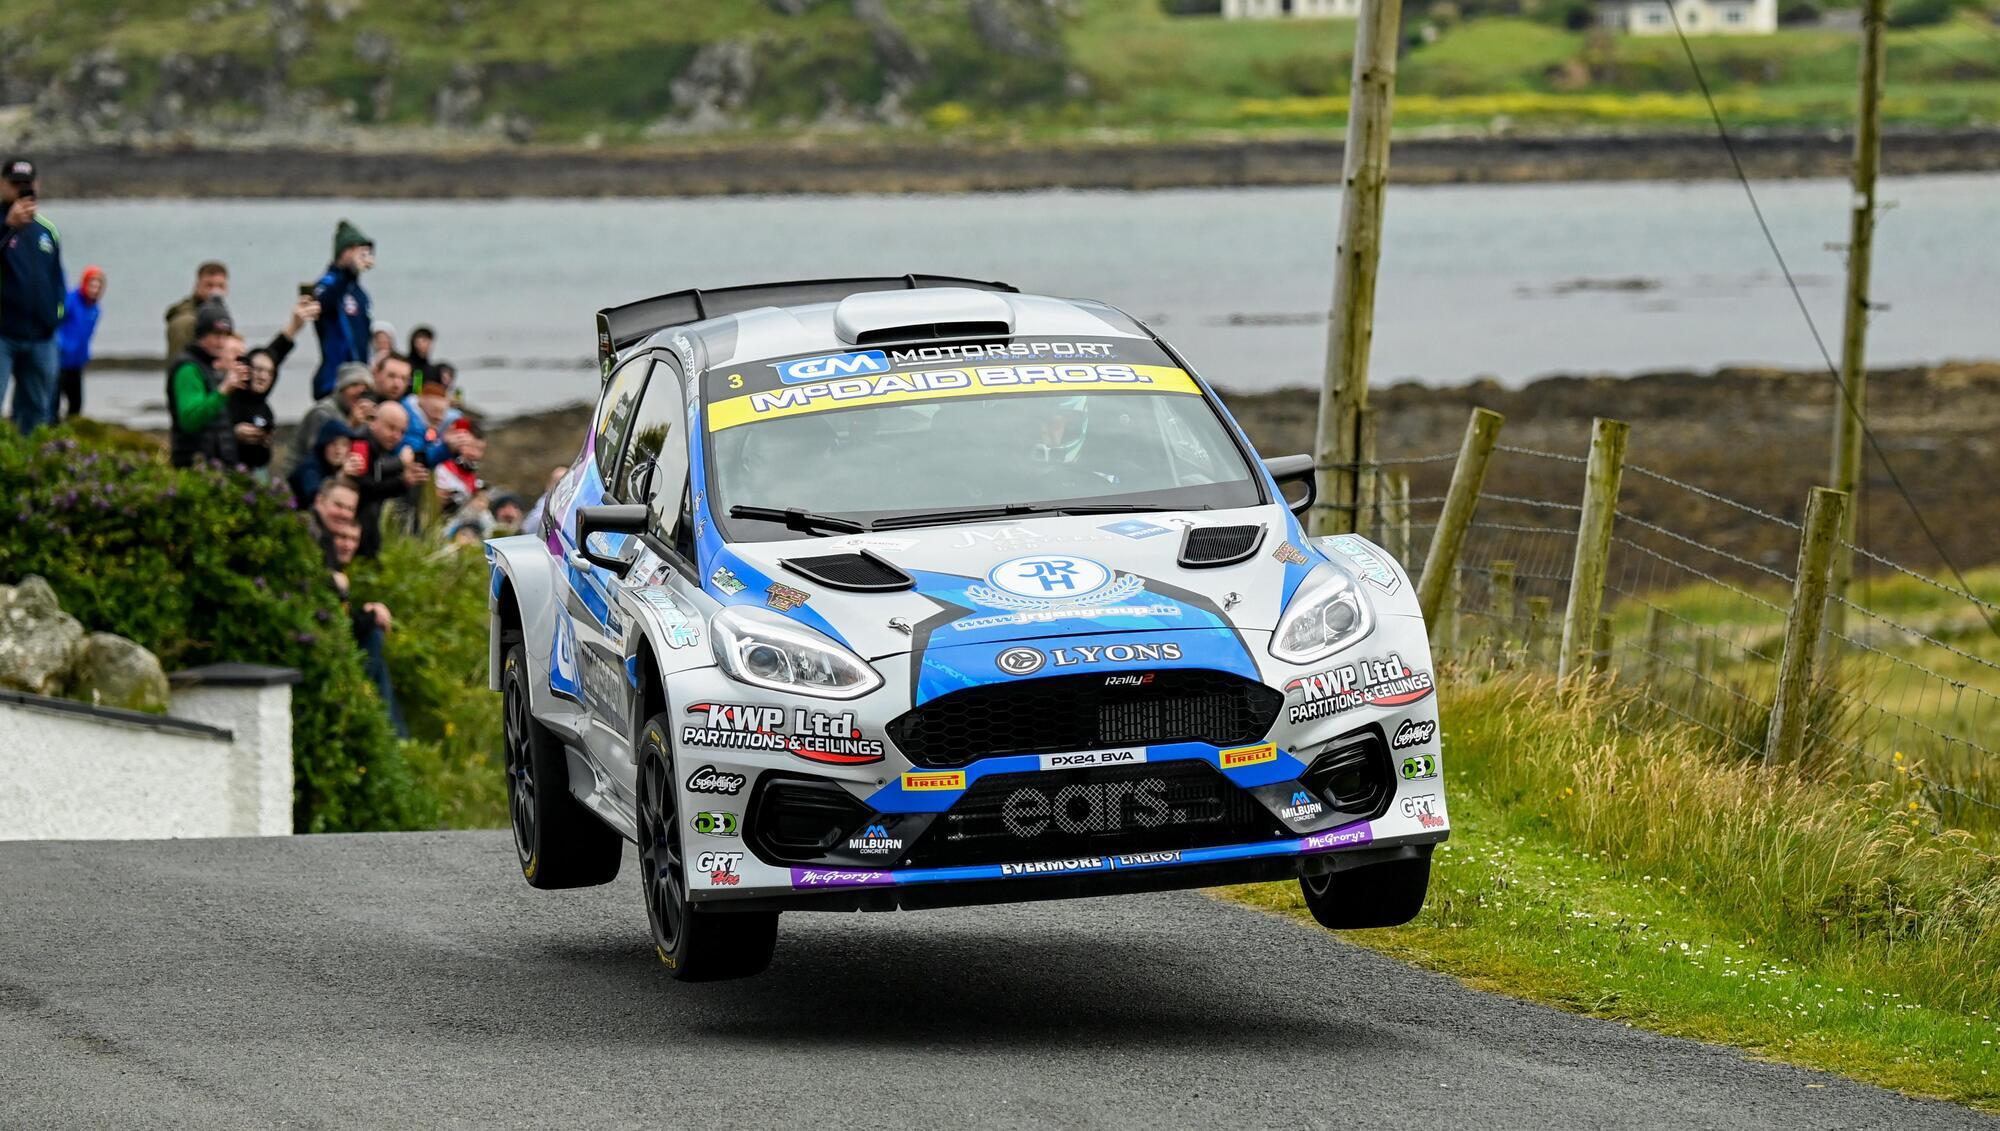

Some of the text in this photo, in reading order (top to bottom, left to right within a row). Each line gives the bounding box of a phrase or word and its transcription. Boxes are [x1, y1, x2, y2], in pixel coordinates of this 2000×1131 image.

[891, 342, 1114, 363] MOTORSPORT
[728, 374, 744, 388] 3
[975, 365, 1153, 386] BROS.
[1052, 642, 1183, 667] LYONS
[1105, 673, 1156, 686] Rally2
[1299, 654, 1412, 703] KWP Ltd.
[1289, 673, 1432, 723] PARTITIONS & CEILINGS
[707, 704, 862, 739] KWP Ltd.
[683, 727, 785, 750] PARTITIONS
[788, 736, 801, 750] &
[804, 737, 885, 756] CEILINGS
[1052, 752, 1134, 767] PX24 BVA
[1225, 747, 1272, 764] PIRELLI
[907, 774, 960, 788] PIRELLI
[1281, 803, 1322, 819] MILBURN
[1400, 794, 1436, 818] GRT
[1293, 813, 1316, 823] CONCRETE
[849, 839, 902, 849] MILBURN
[1305, 831, 1365, 848] McGrory's
[697, 851, 743, 872] GRT
[1001, 852, 1182, 875] EVERMORE ENERGY
[800, 868, 883, 884] McGrory's
